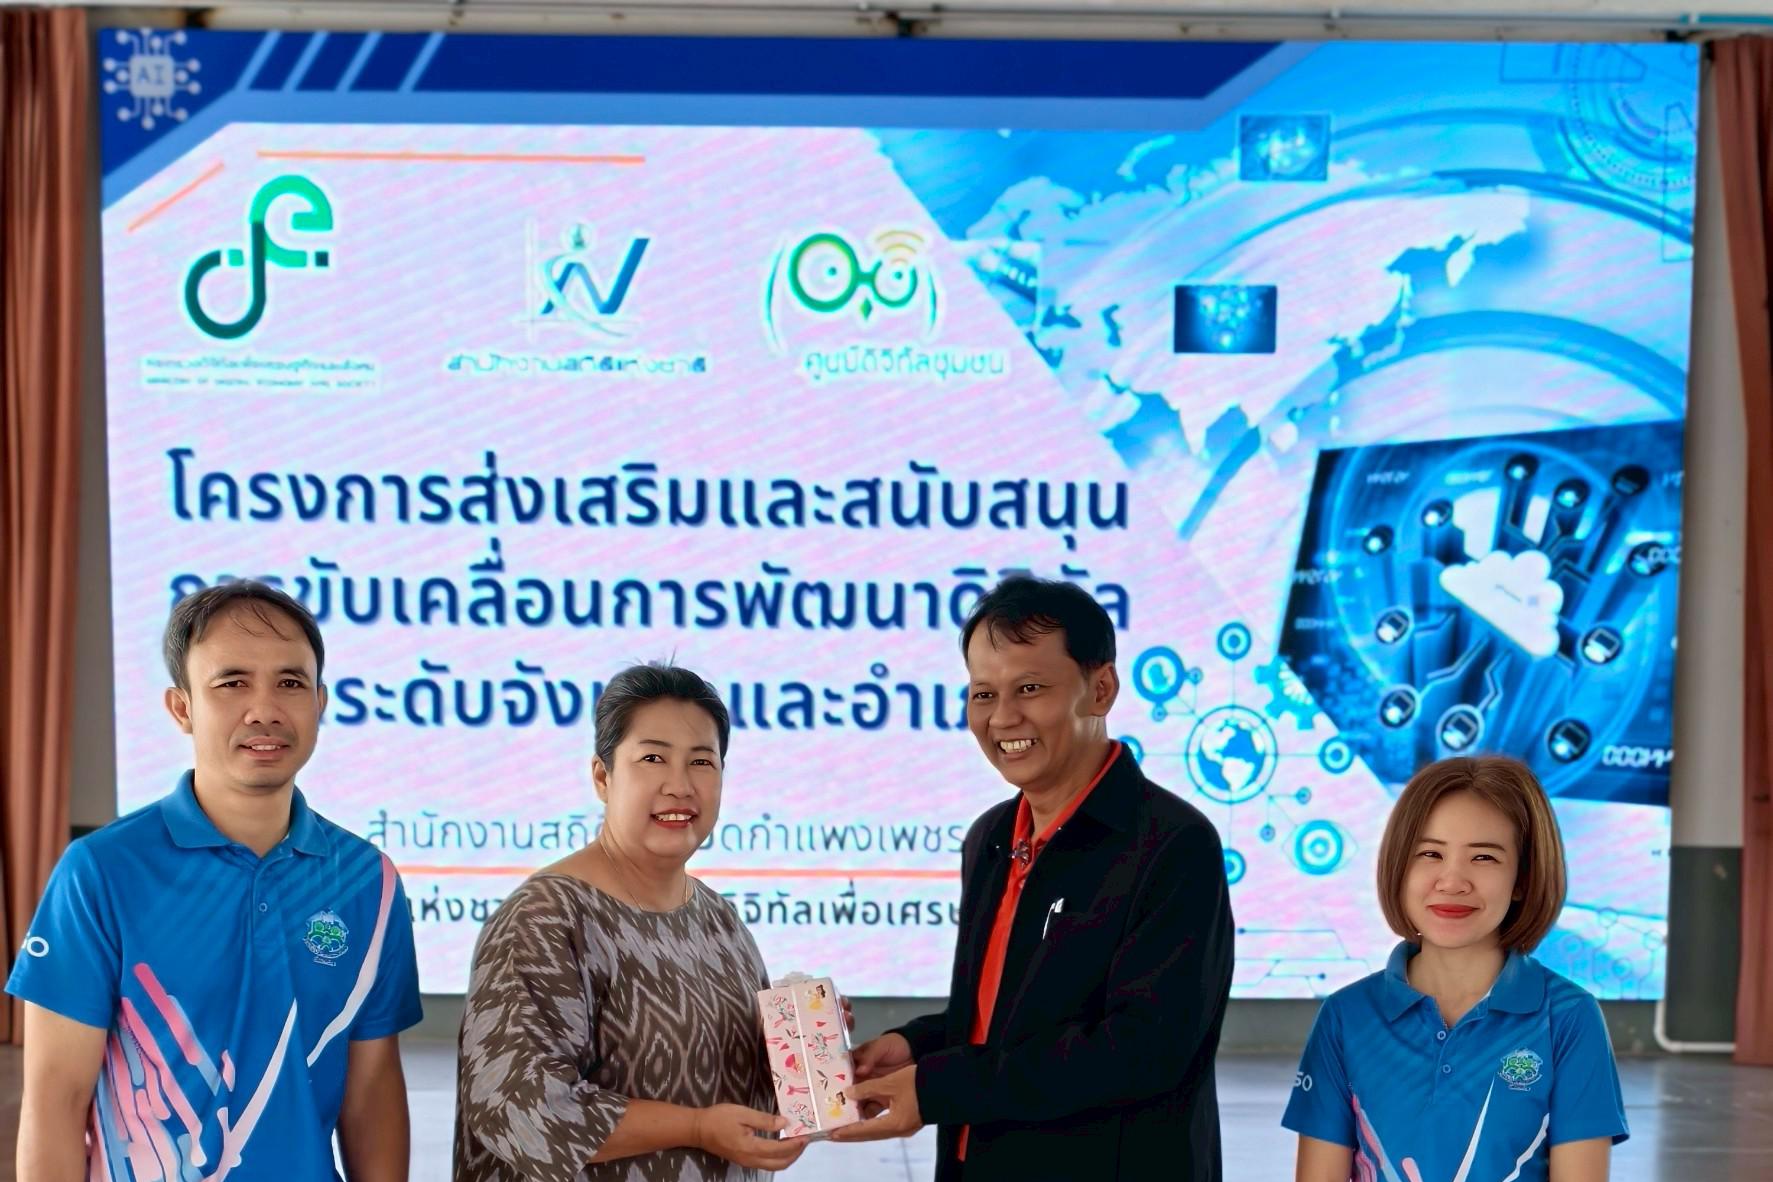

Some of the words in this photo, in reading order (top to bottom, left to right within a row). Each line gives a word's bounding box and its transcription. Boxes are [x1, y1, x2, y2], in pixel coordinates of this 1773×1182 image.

[137, 63, 165, 86] AI
[166, 447, 1129, 551] โครงการส่งเสริมและสนับสนุน
